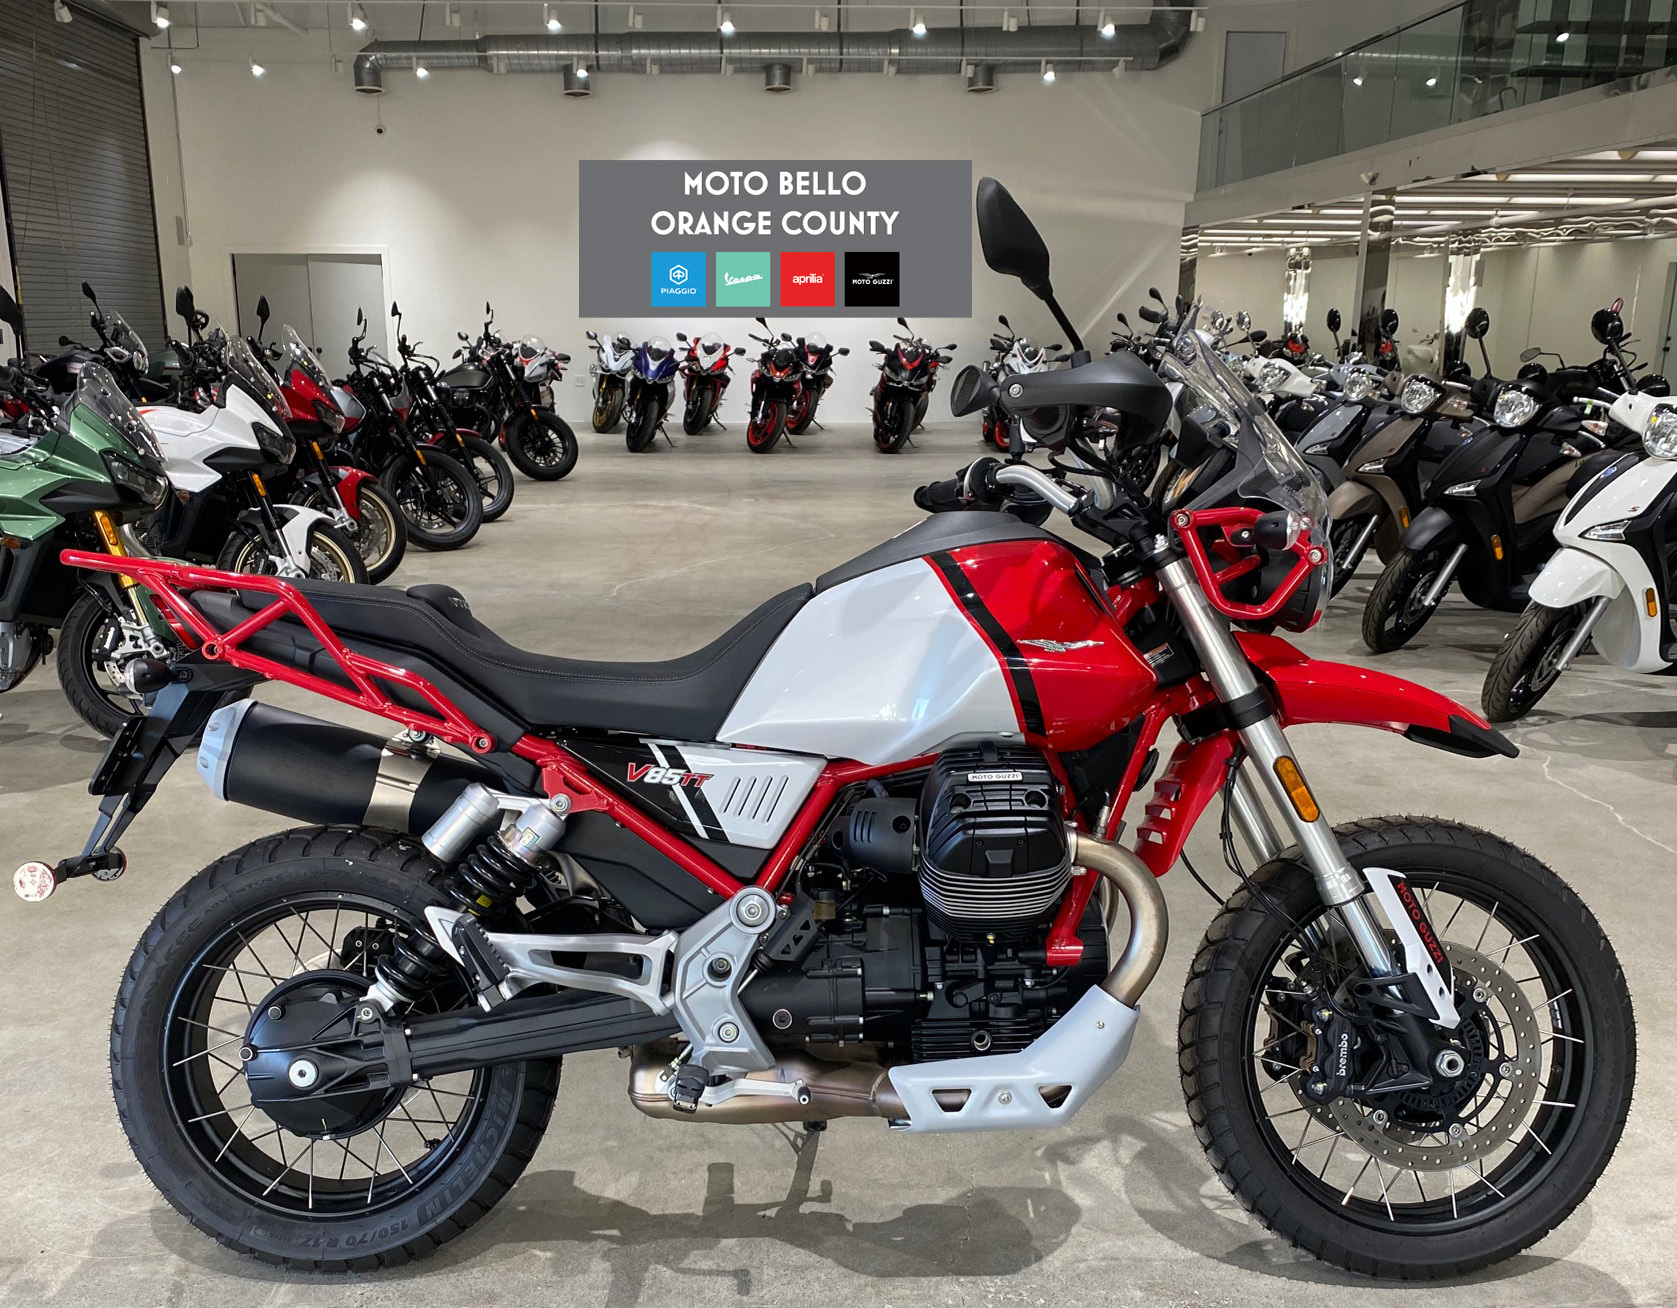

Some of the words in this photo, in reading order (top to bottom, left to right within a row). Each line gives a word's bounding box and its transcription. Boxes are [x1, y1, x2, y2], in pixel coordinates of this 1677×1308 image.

[627, 762, 714, 788] V85TT
[1397, 880, 1420, 920] MOTO
[1419, 921, 1443, 963] GUZZI
[1336, 1033, 1348, 1076] brembo
[425, 1087, 513, 1219] MICHELIN
[345, 1219, 409, 1247] 150/70
